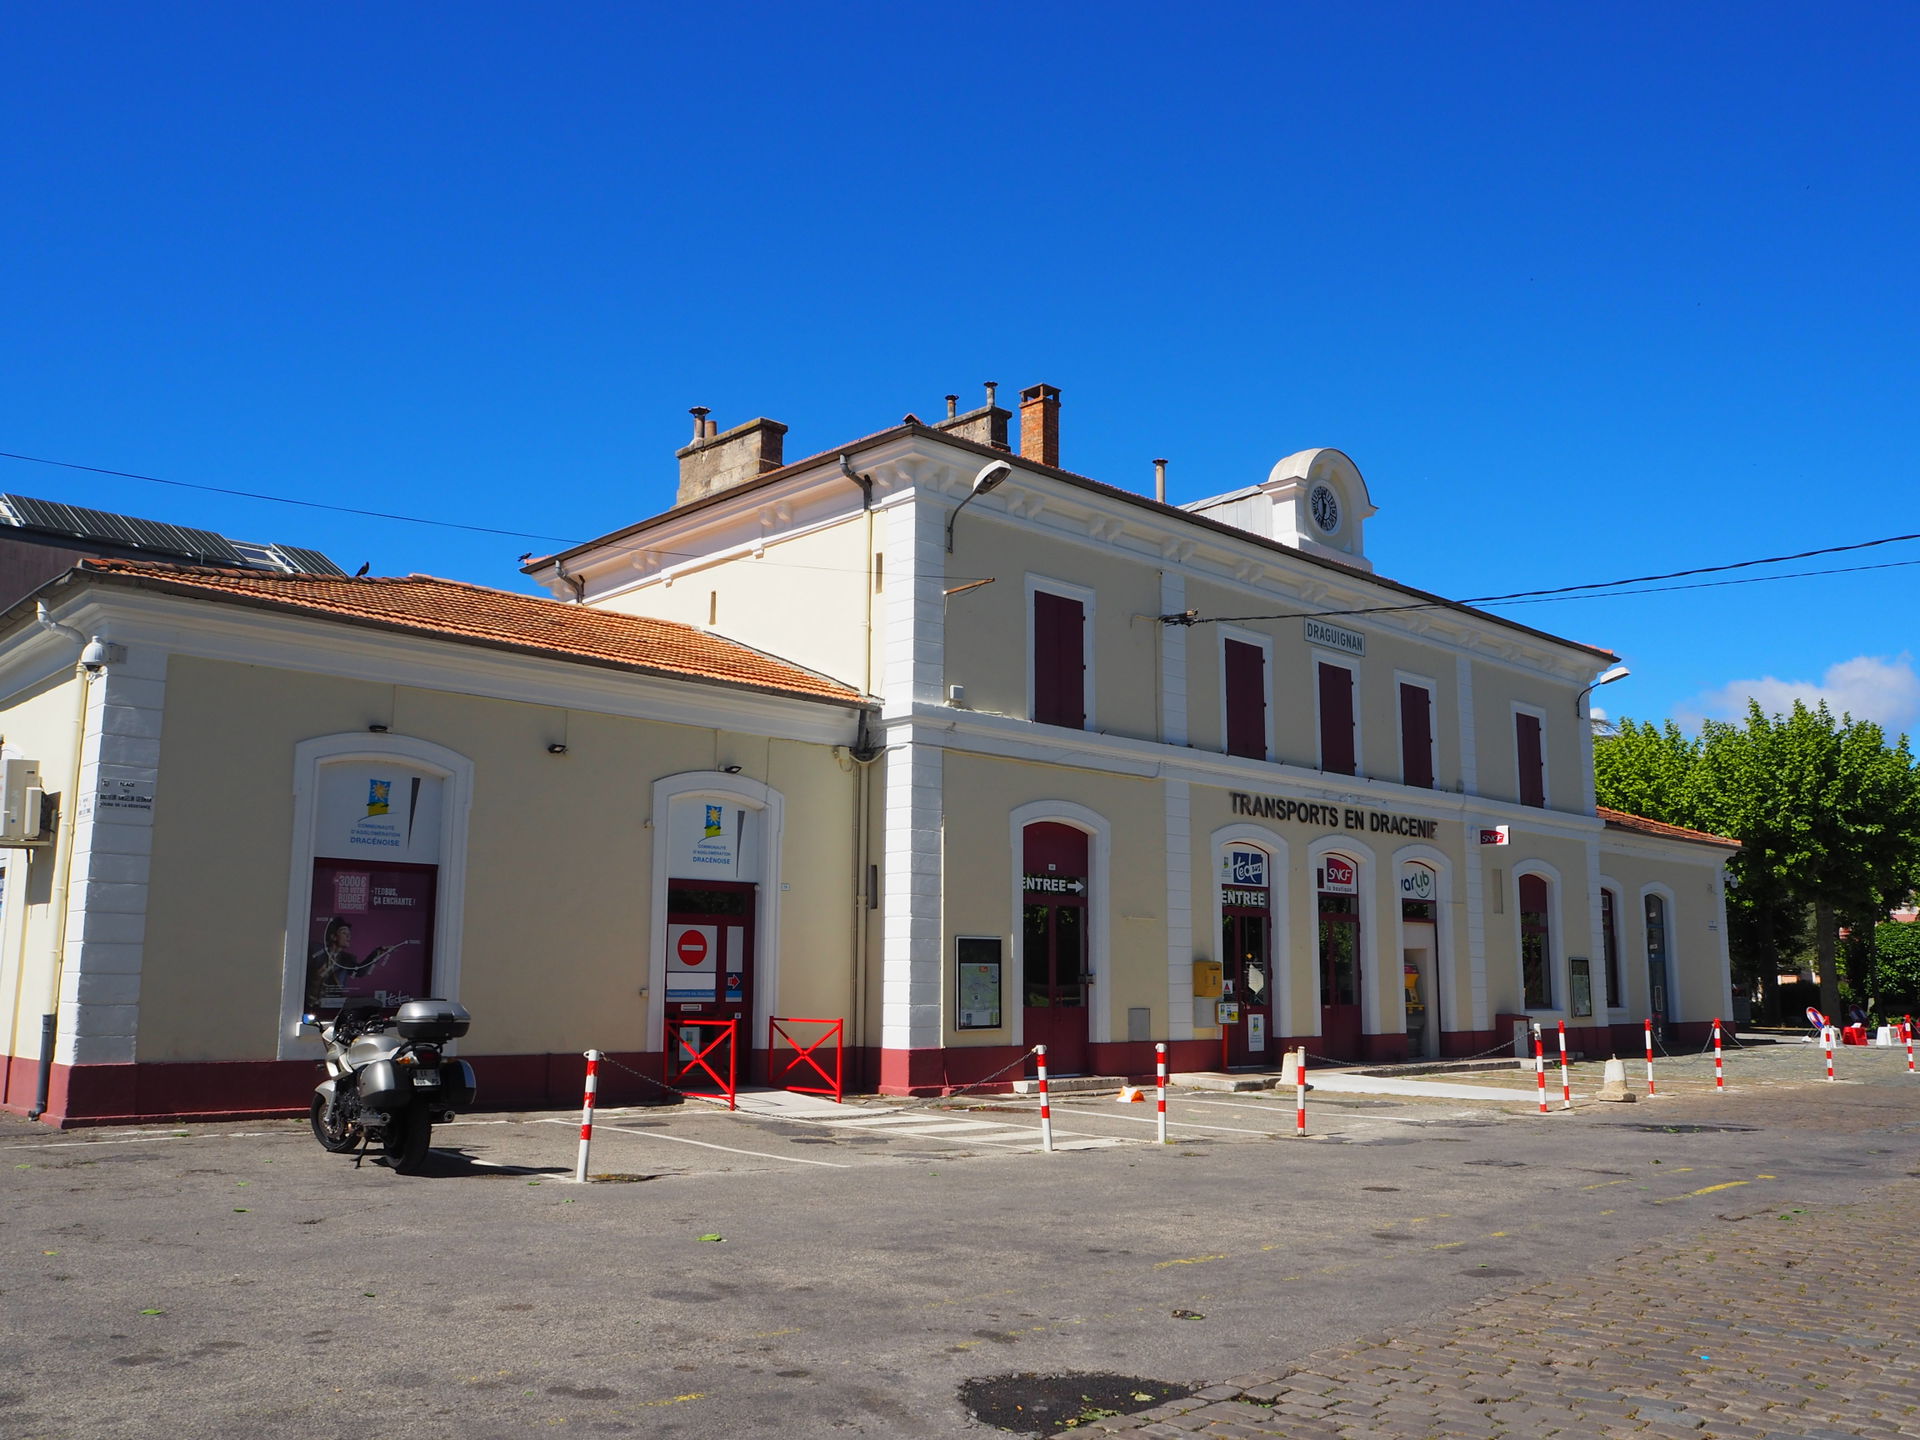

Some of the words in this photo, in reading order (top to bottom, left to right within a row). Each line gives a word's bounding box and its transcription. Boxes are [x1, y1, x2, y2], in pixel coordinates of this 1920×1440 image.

[1307, 622, 1363, 653] DRAGUIGNAN
[1230, 791, 1338, 827] TRANSPORTS
[1344, 809, 1365, 830] EN
[1370, 812, 1439, 840] DRACENIE
[350, 836, 401, 847] DRACÉNOISE
[1481, 834, 1504, 843] SNCF
[1328, 867, 1352, 881] SNCF
[338, 893, 366, 903] BUDGET
[382, 896, 412, 906] ENCHANTE
[1222, 890, 1265, 906] ENTREE
